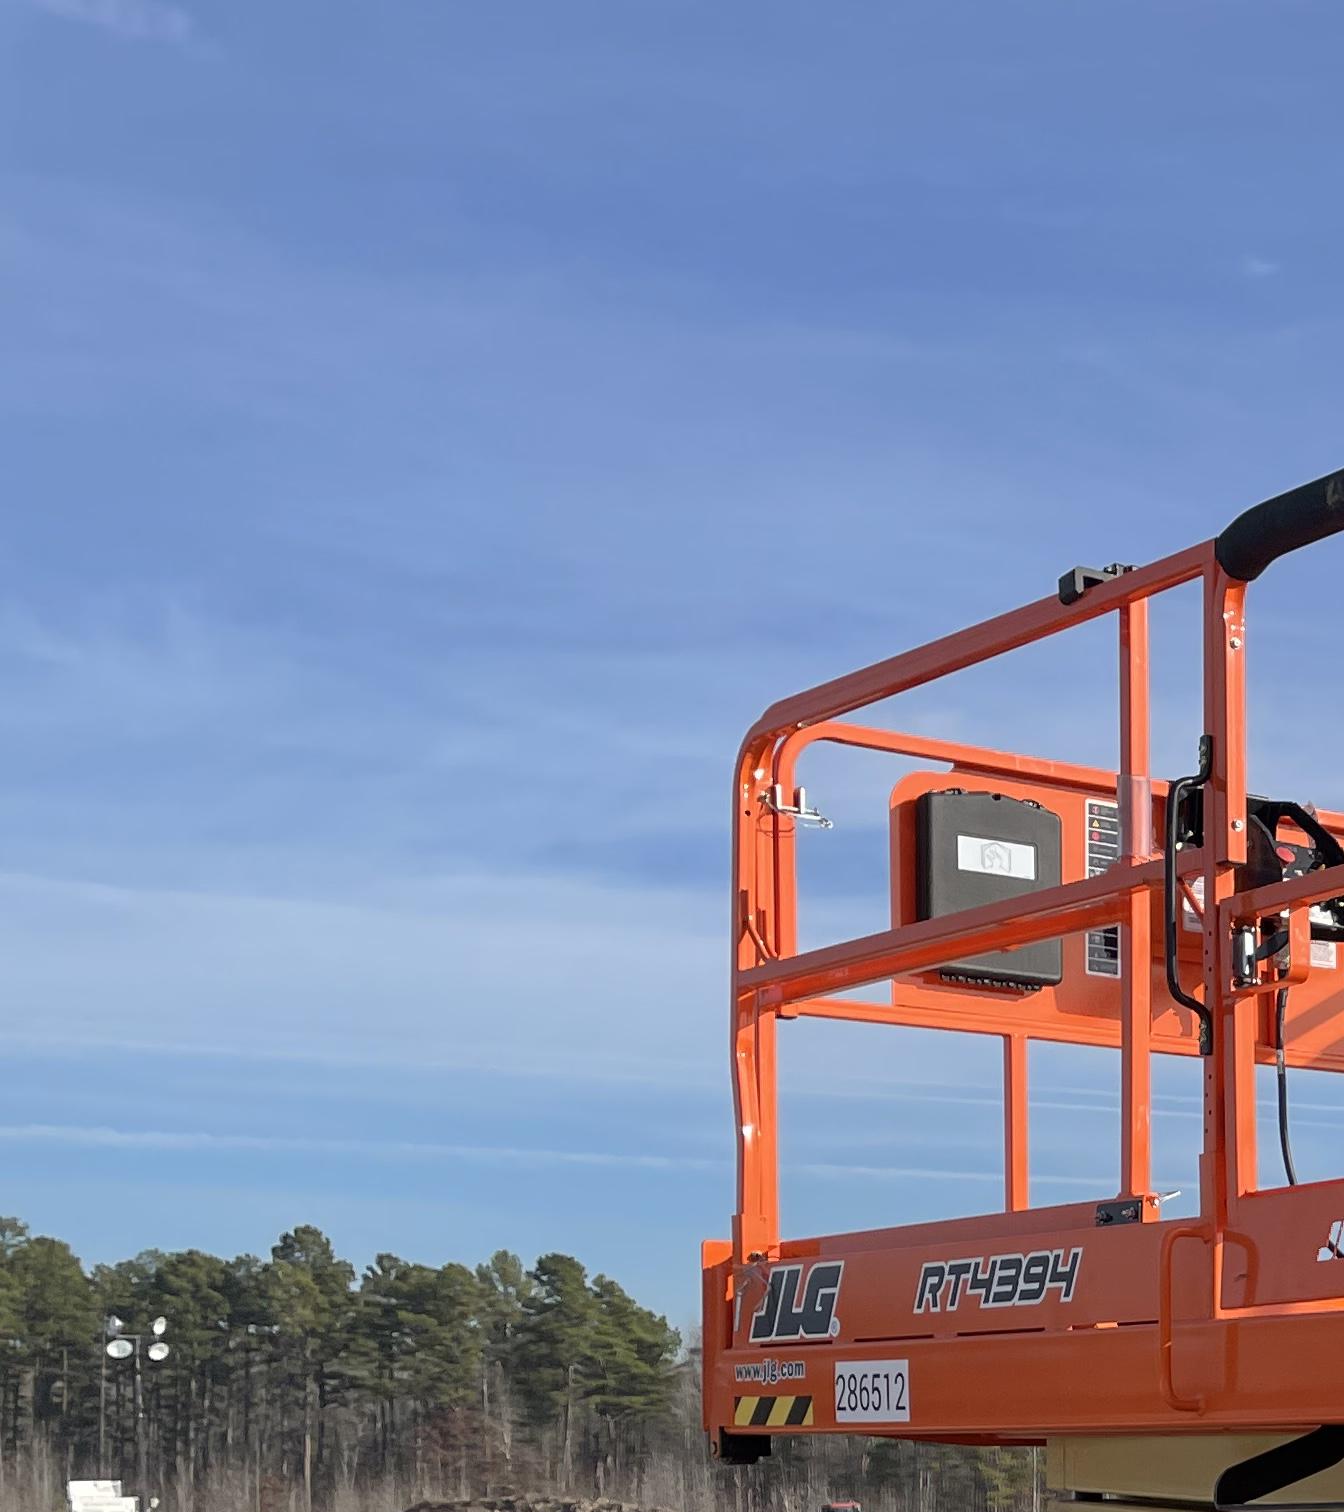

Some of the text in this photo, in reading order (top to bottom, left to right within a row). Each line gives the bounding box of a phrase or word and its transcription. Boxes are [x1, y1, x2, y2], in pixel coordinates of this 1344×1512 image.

[913, 1247, 1083, 1314] RT4394
[735, 1358, 806, 1385] www.jlg.com
[835, 1371, 907, 1413] 286512
